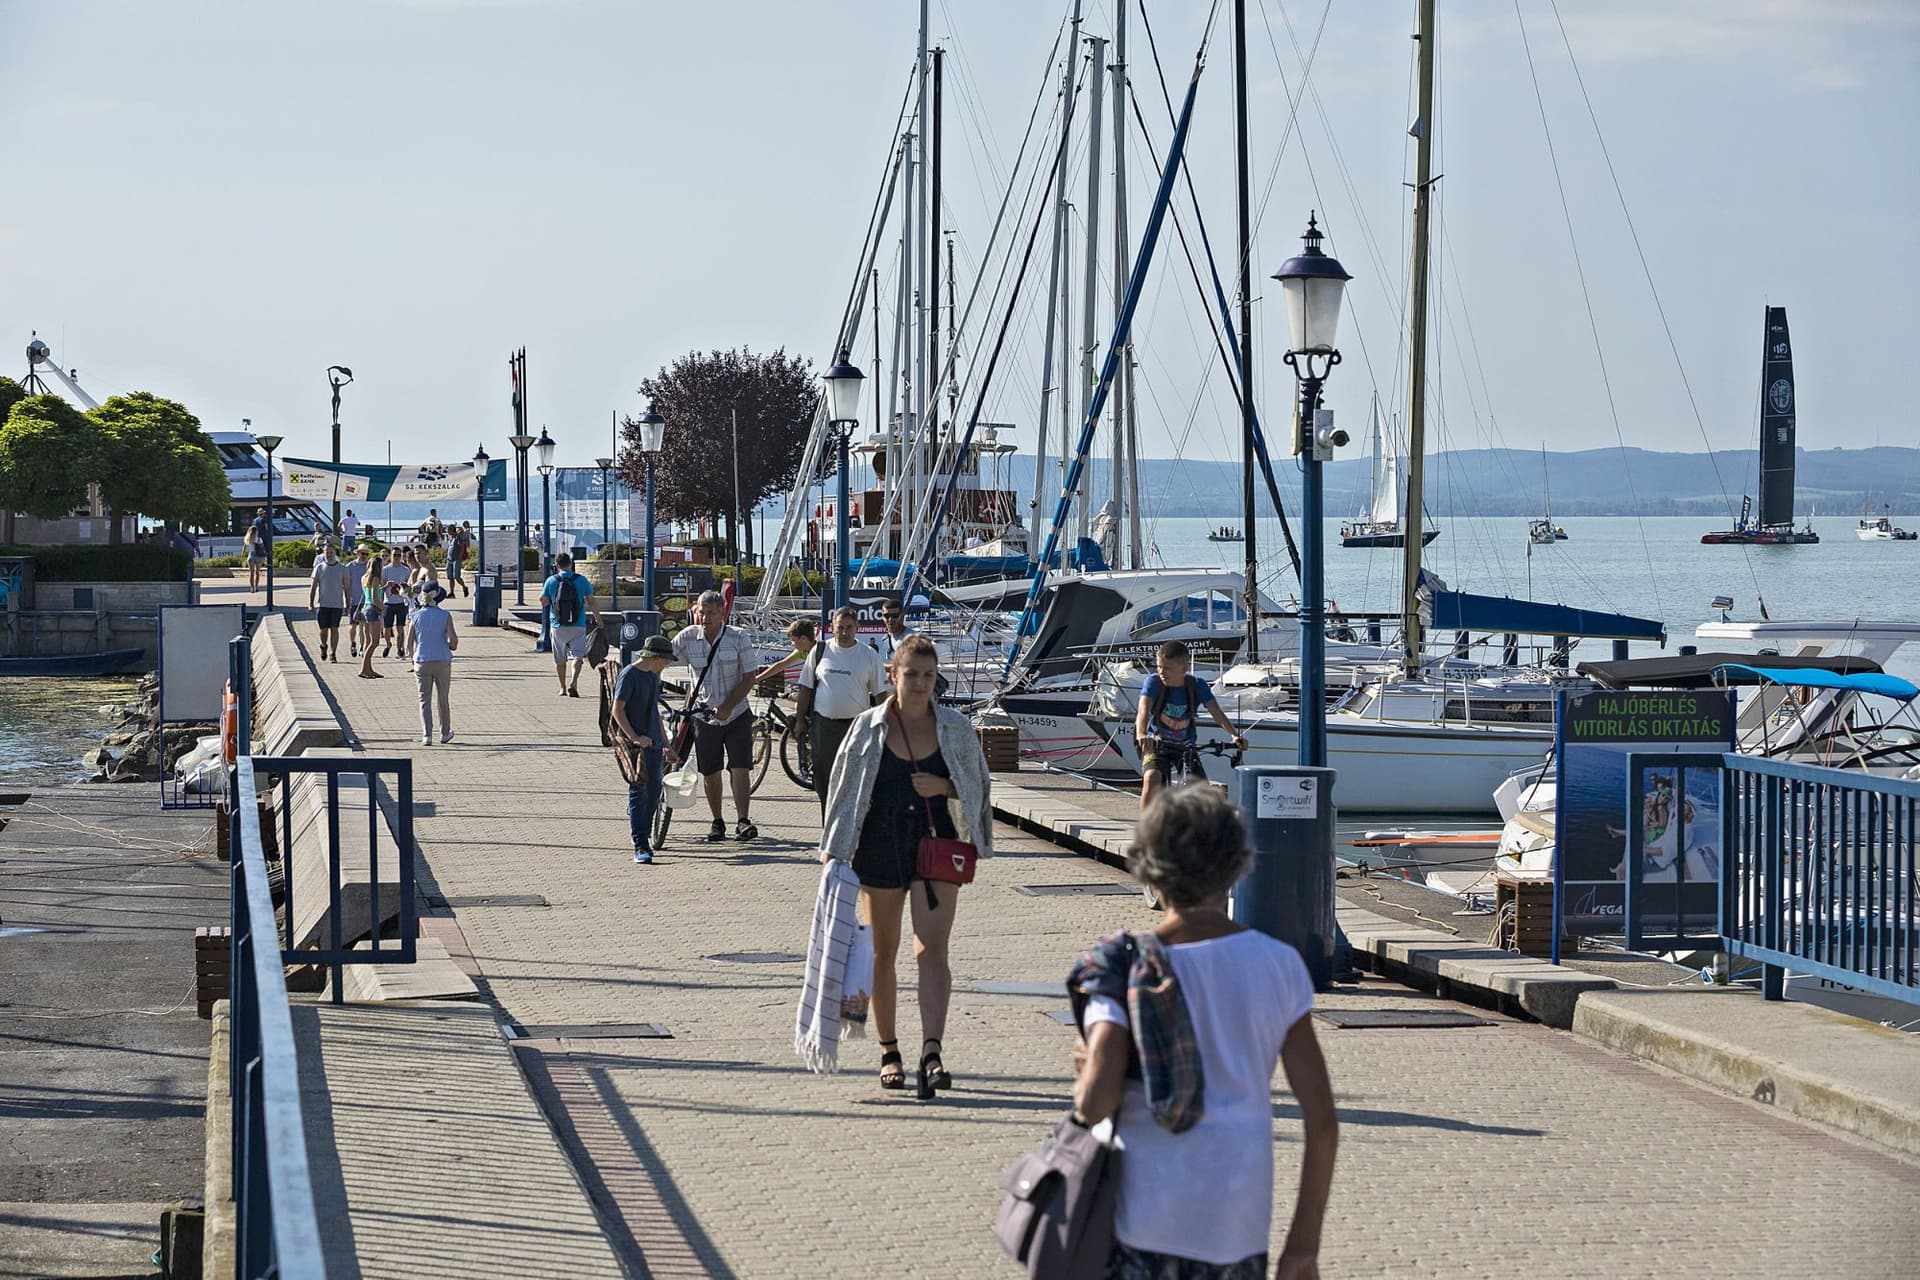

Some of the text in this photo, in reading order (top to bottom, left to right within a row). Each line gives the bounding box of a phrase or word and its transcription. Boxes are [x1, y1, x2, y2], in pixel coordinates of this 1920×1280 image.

[1598, 694, 1697, 715] HAJÓBÉRLÉS
[1018, 717, 1058, 729] H-34593
[1573, 715, 1721, 737] VITORLÁS OKTATÁS
[1591, 904, 1624, 915] VEGA
